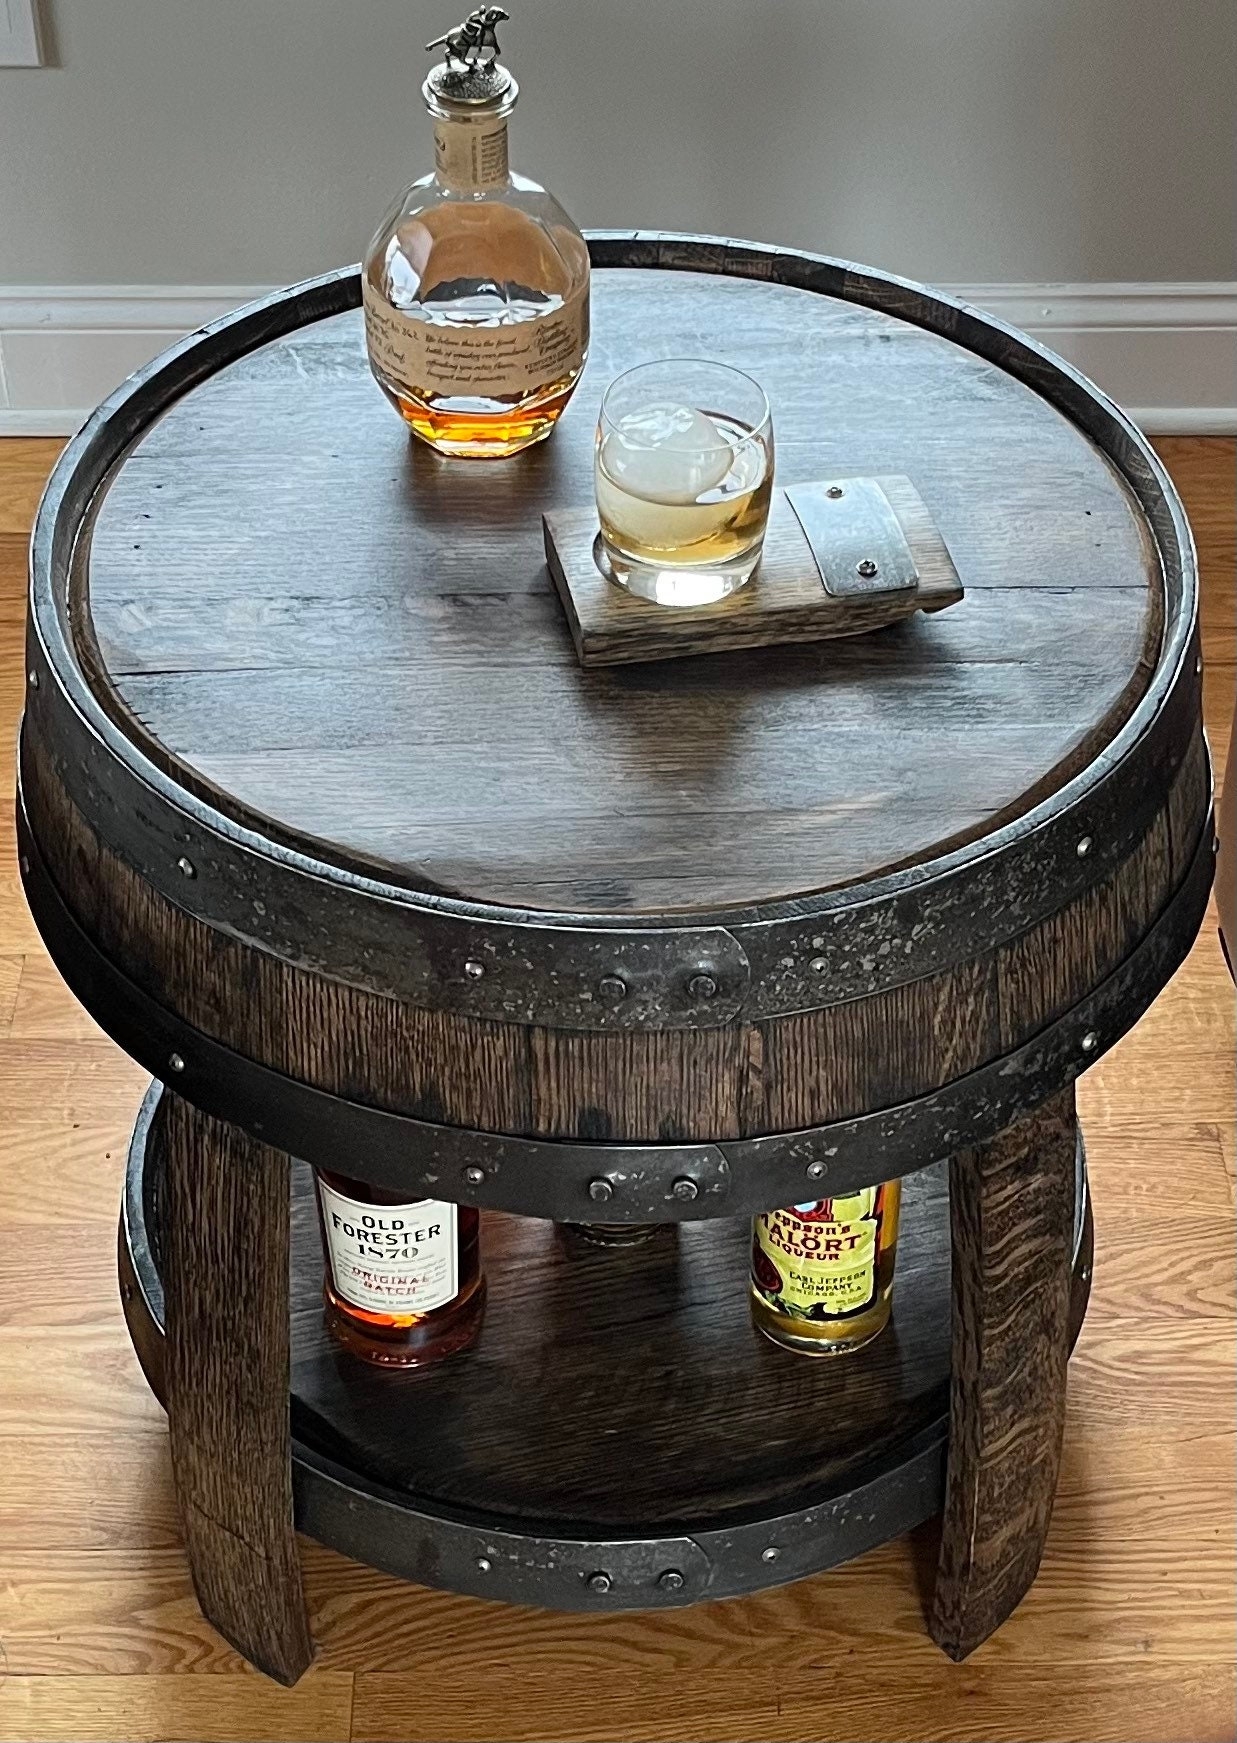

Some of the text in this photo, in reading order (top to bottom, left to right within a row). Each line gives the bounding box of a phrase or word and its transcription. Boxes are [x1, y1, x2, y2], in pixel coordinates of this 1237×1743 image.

[332, 1212, 442, 1246] FORESTER
[361, 1215, 405, 1231] OLD
[774, 1211, 851, 1236] eppson's
[769, 1233, 841, 1261] LIQUEUR
[351, 1266, 430, 1285] ORIGINAL
[363, 1280, 417, 1296] BATCH
[801, 1281, 853, 1292] COMPANY
